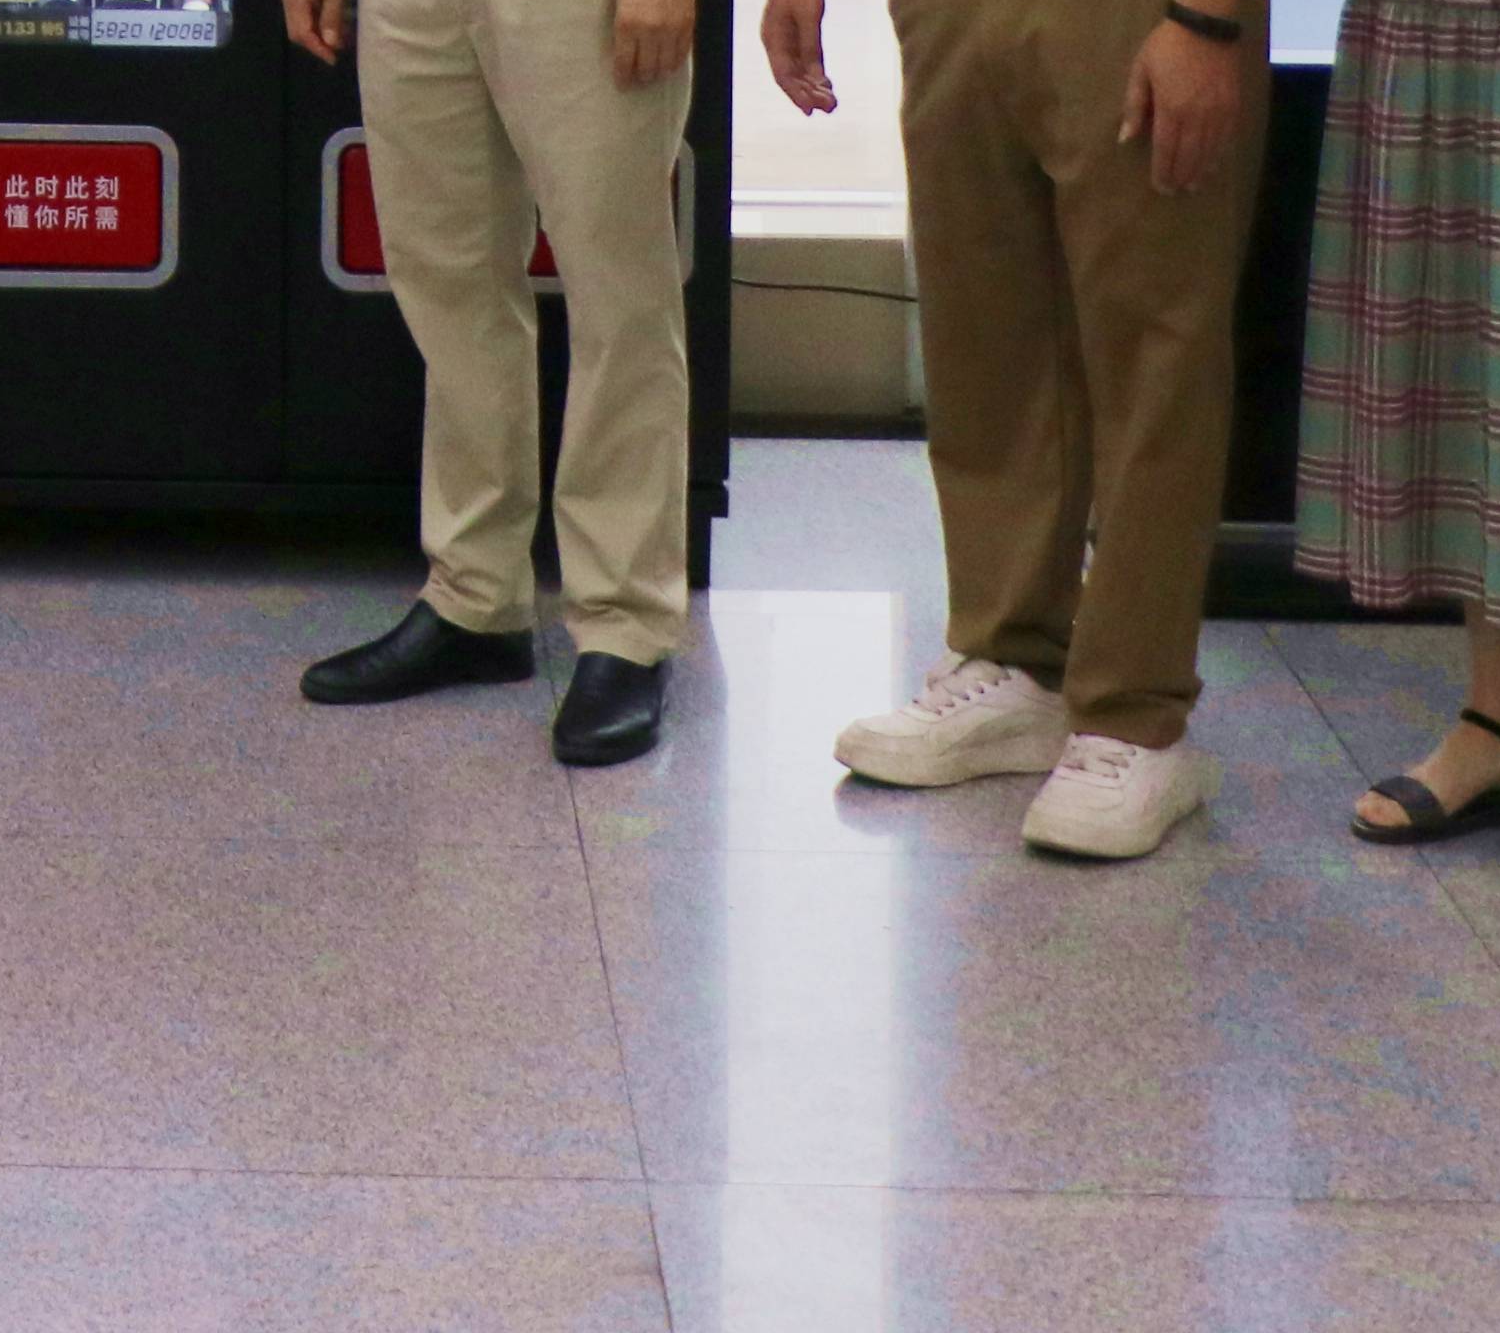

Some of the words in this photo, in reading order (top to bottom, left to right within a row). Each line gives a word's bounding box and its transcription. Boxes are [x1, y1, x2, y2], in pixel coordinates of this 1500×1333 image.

[4, 174, 120, 201] 此时此刻
[4, 204, 120, 231] 懂你所需
